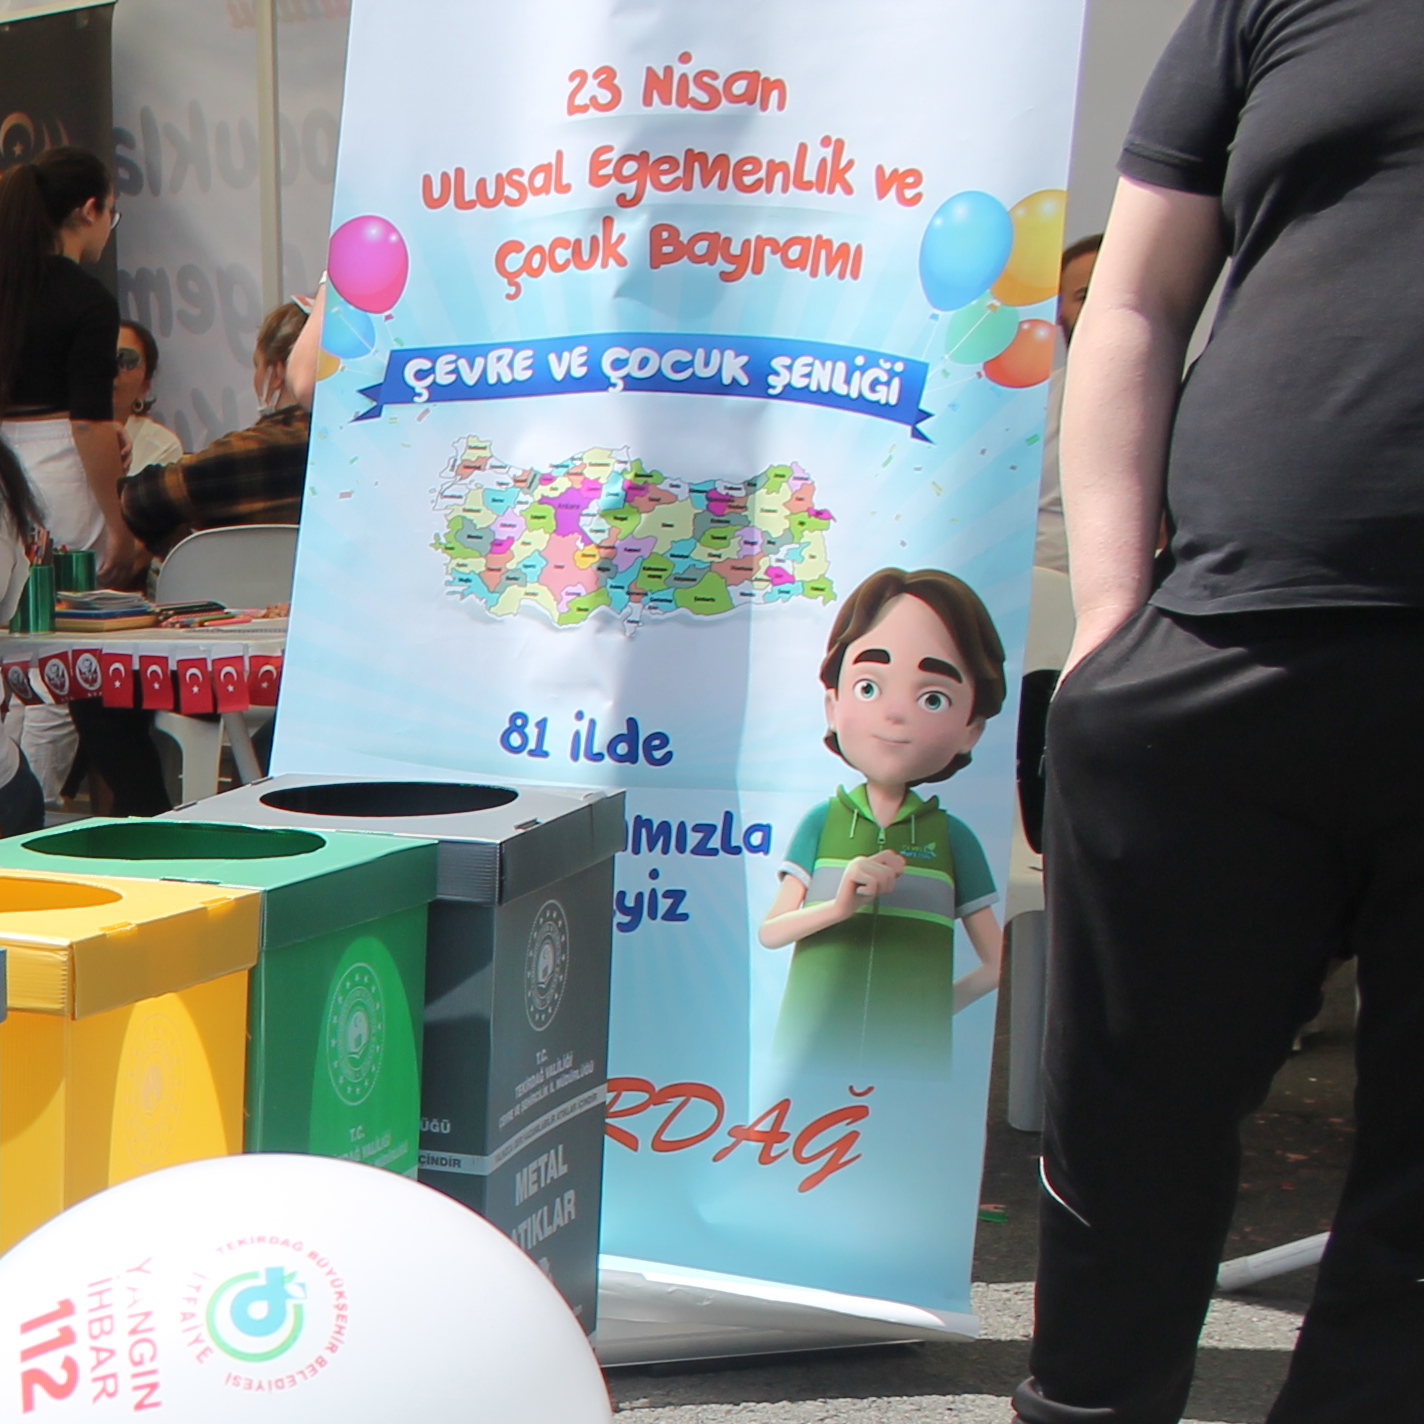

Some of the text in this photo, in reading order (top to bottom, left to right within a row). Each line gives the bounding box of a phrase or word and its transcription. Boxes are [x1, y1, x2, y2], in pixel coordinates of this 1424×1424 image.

[566, 51, 787, 117] 23 Nisan
[422, 134, 924, 211] Ulusal Egemenlik ve
[495, 215, 863, 300] Çocuk Bayramı
[404, 345, 905, 406] ÇEVRE VE ÇOCUK ŞENLİĞİ
[500, 710, 674, 767] 81 ilde
[613, 868, 690, 933] yiz
[515, 1144, 568, 1206] METAL
[125, 1257, 163, 1412] YANGIN
[179, 1272, 216, 1365] İTFAİYE
[215, 1235, 349, 1394] TEKİRDAĞ BÜYÜKŞEHİR BELEDİYESİ
[19, 1297, 80, 1415] 112
